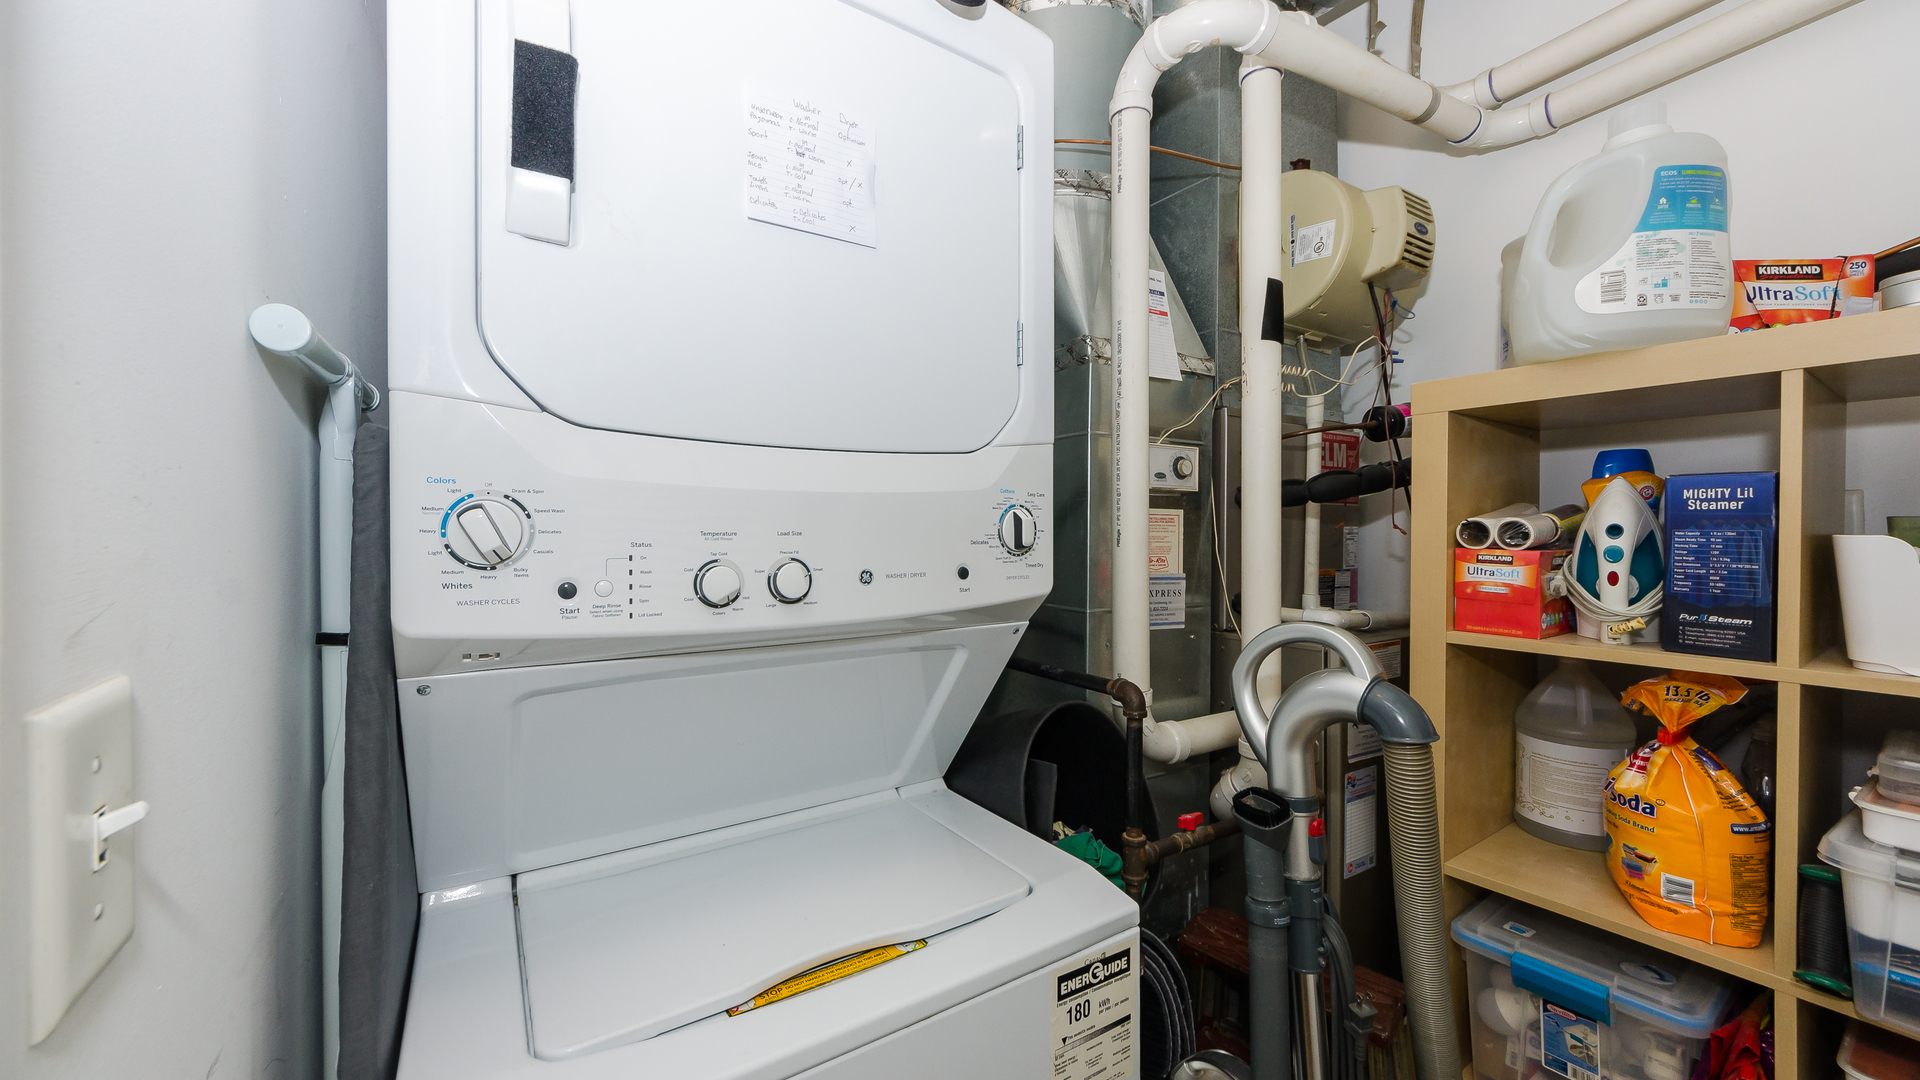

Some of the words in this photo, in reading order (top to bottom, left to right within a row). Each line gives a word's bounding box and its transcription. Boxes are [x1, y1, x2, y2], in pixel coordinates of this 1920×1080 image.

[793, 98, 822, 115] Washer
[839, 113, 859, 134] Dryer
[1758, 265, 1821, 275] KIRKLAND
[1849, 261, 1867, 269] 250
[1746, 285, 1844, 304] UltraSoft
[426, 476, 457, 485] Colors
[1683, 488, 1731, 499] MIGHTY
[1737, 487, 1753, 498] Lil
[1688, 500, 1744, 510] Steamer
[1467, 566, 1521, 579] UltraSoft
[441, 582, 473, 590] Whites
[456, 599, 490, 607] WASHER
[491, 598, 520, 606] CYCLES
[559, 607, 581, 615] Start
[1679, 613, 1698, 621] Pur
[1708, 615, 1753, 625] Steam
[1665, 685, 1694, 697] 13.5
[1618, 815, 1631, 826] Soda
[1632, 821, 1655, 833] Brand
[1060, 957, 1128, 996] ENERGUIDE
[759, 987, 783, 1000] STOP
[1098, 998, 1111, 1008] kWh
[1066, 999, 1091, 1025] 180
